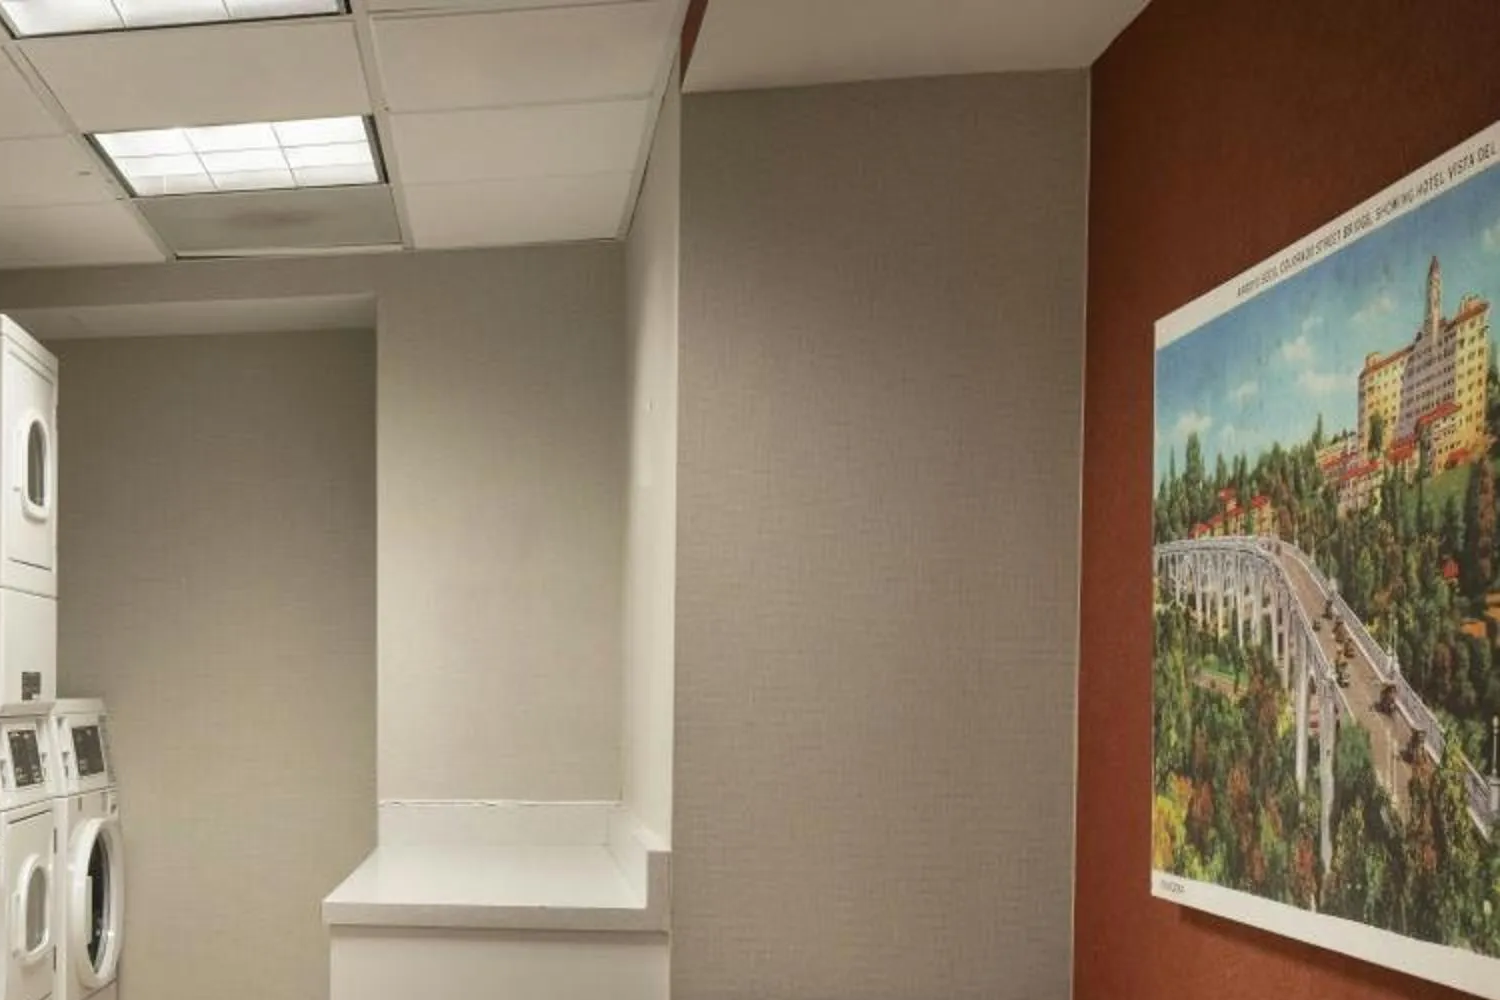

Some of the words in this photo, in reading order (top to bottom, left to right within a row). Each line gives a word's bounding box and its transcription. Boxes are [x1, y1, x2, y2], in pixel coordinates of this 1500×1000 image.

[1416, 170, 1445, 197] HOTEL
[1447, 153, 1475, 180] VISTA
[1477, 140, 1497, 162] DEL
